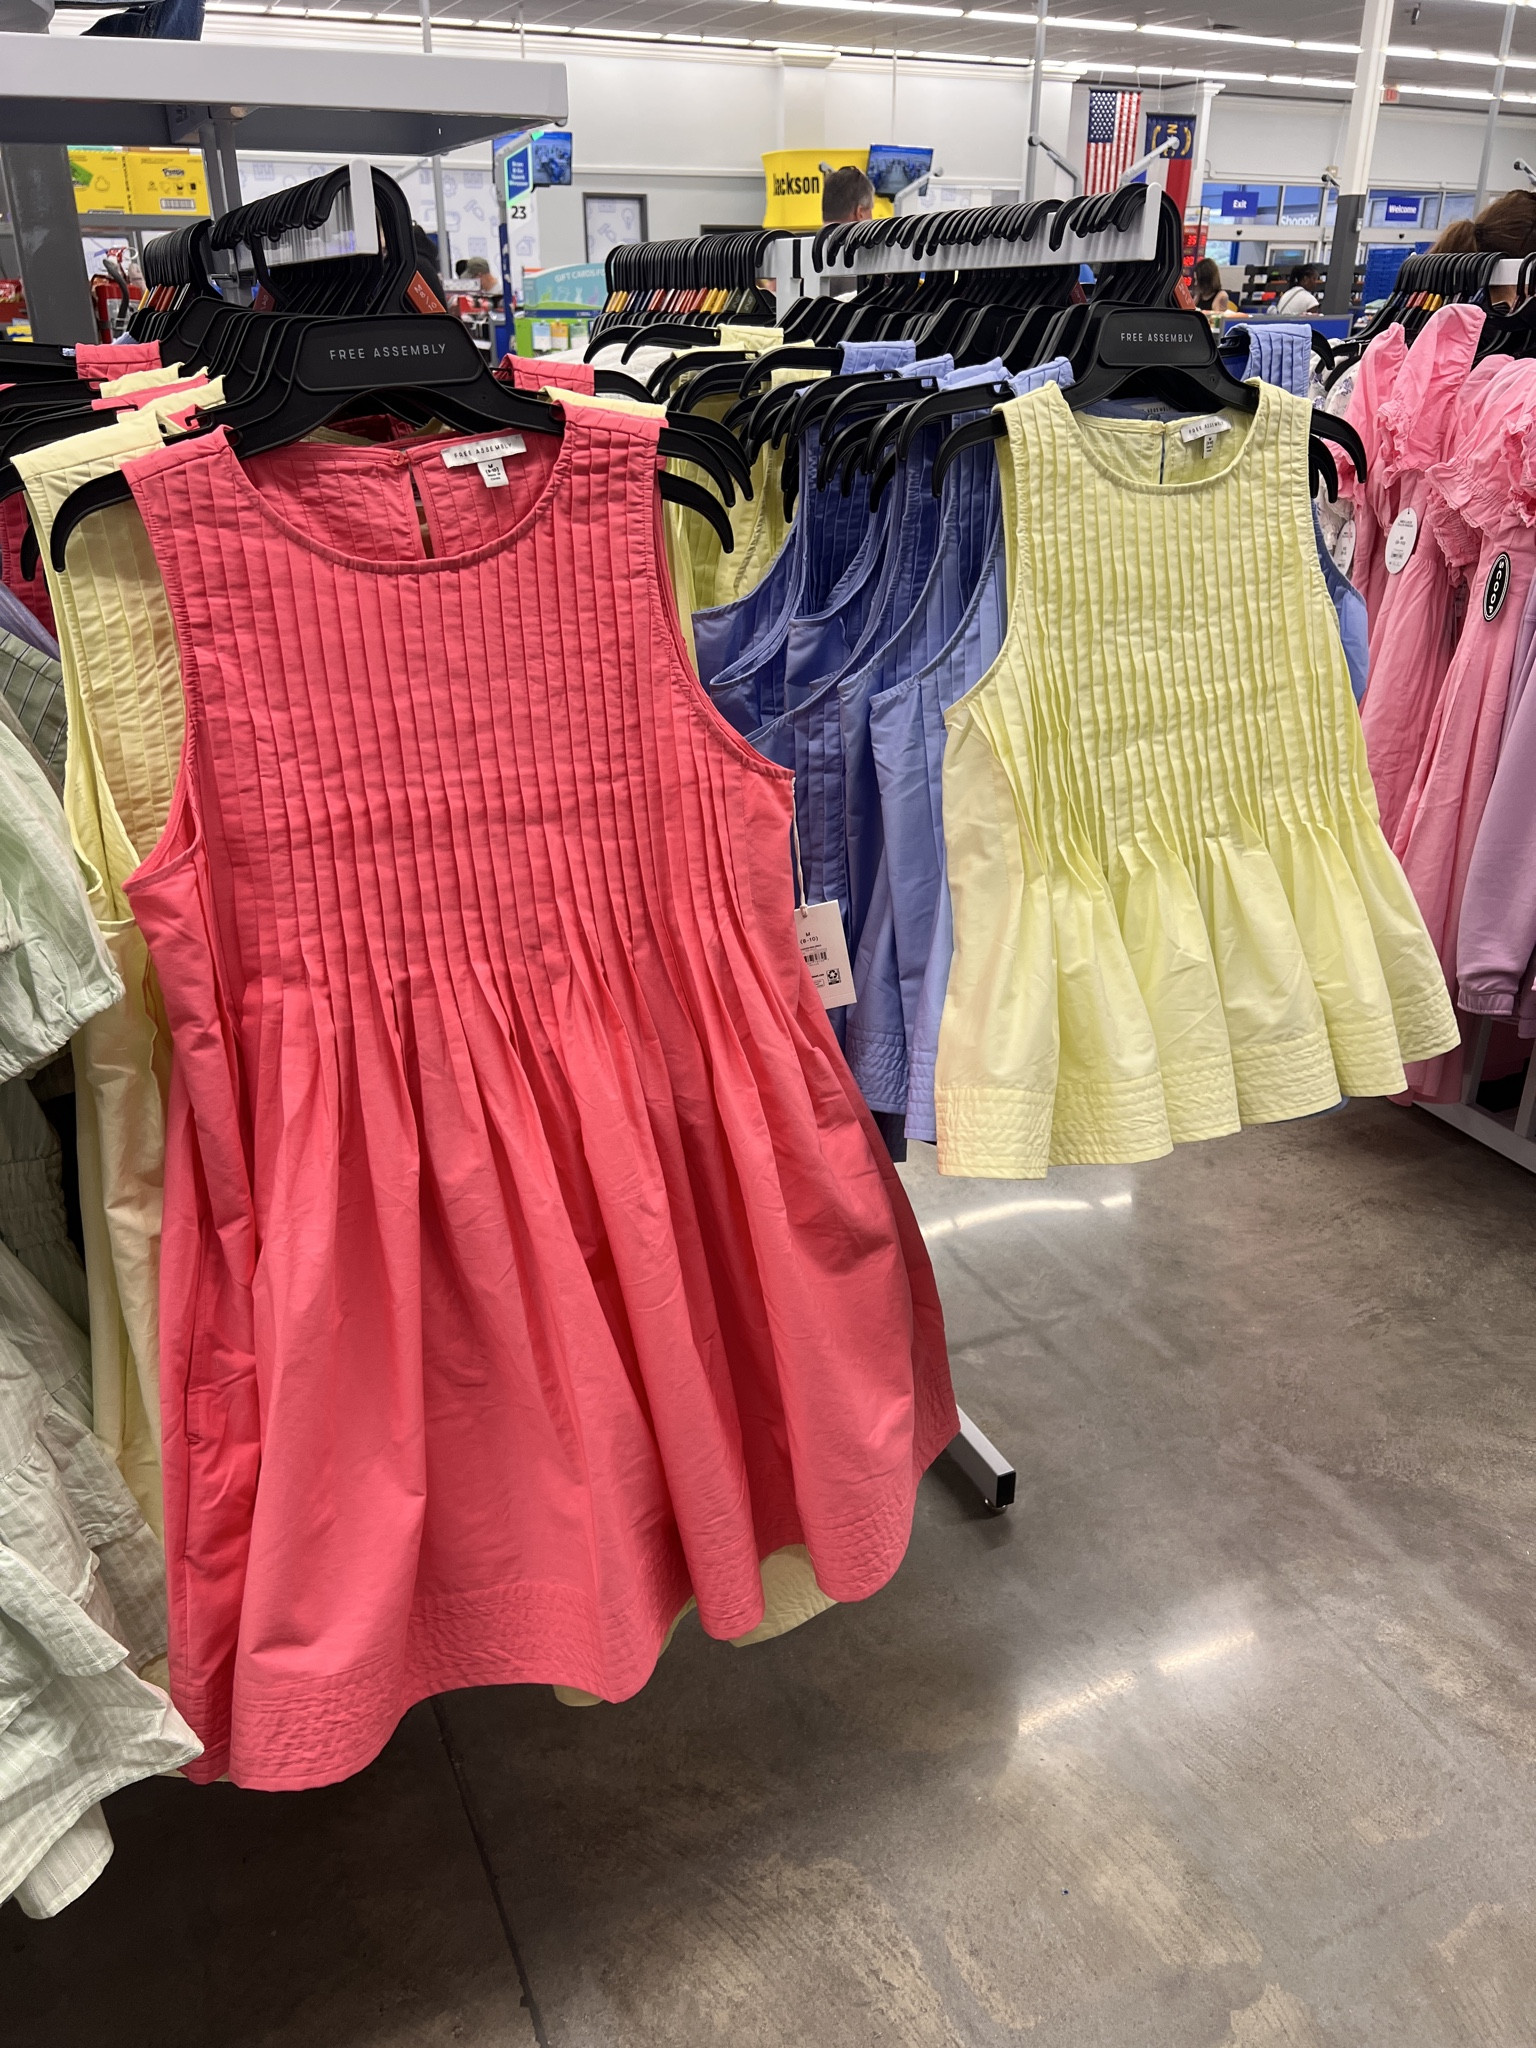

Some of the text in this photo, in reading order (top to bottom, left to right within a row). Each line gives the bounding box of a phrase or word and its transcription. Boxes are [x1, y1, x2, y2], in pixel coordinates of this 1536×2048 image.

[1232, 199, 1247, 209] Exit
[1389, 204, 1417, 214] Welcome
[511, 205, 526, 219] 23
[1120, 332, 1194, 343] FREE ASSEMBLY
[329, 344, 446, 360] FREE ASSEMBLY
[454, 443, 512, 458] FREE ASSEMBLY
[1488, 561, 1504, 614] SCOOP
